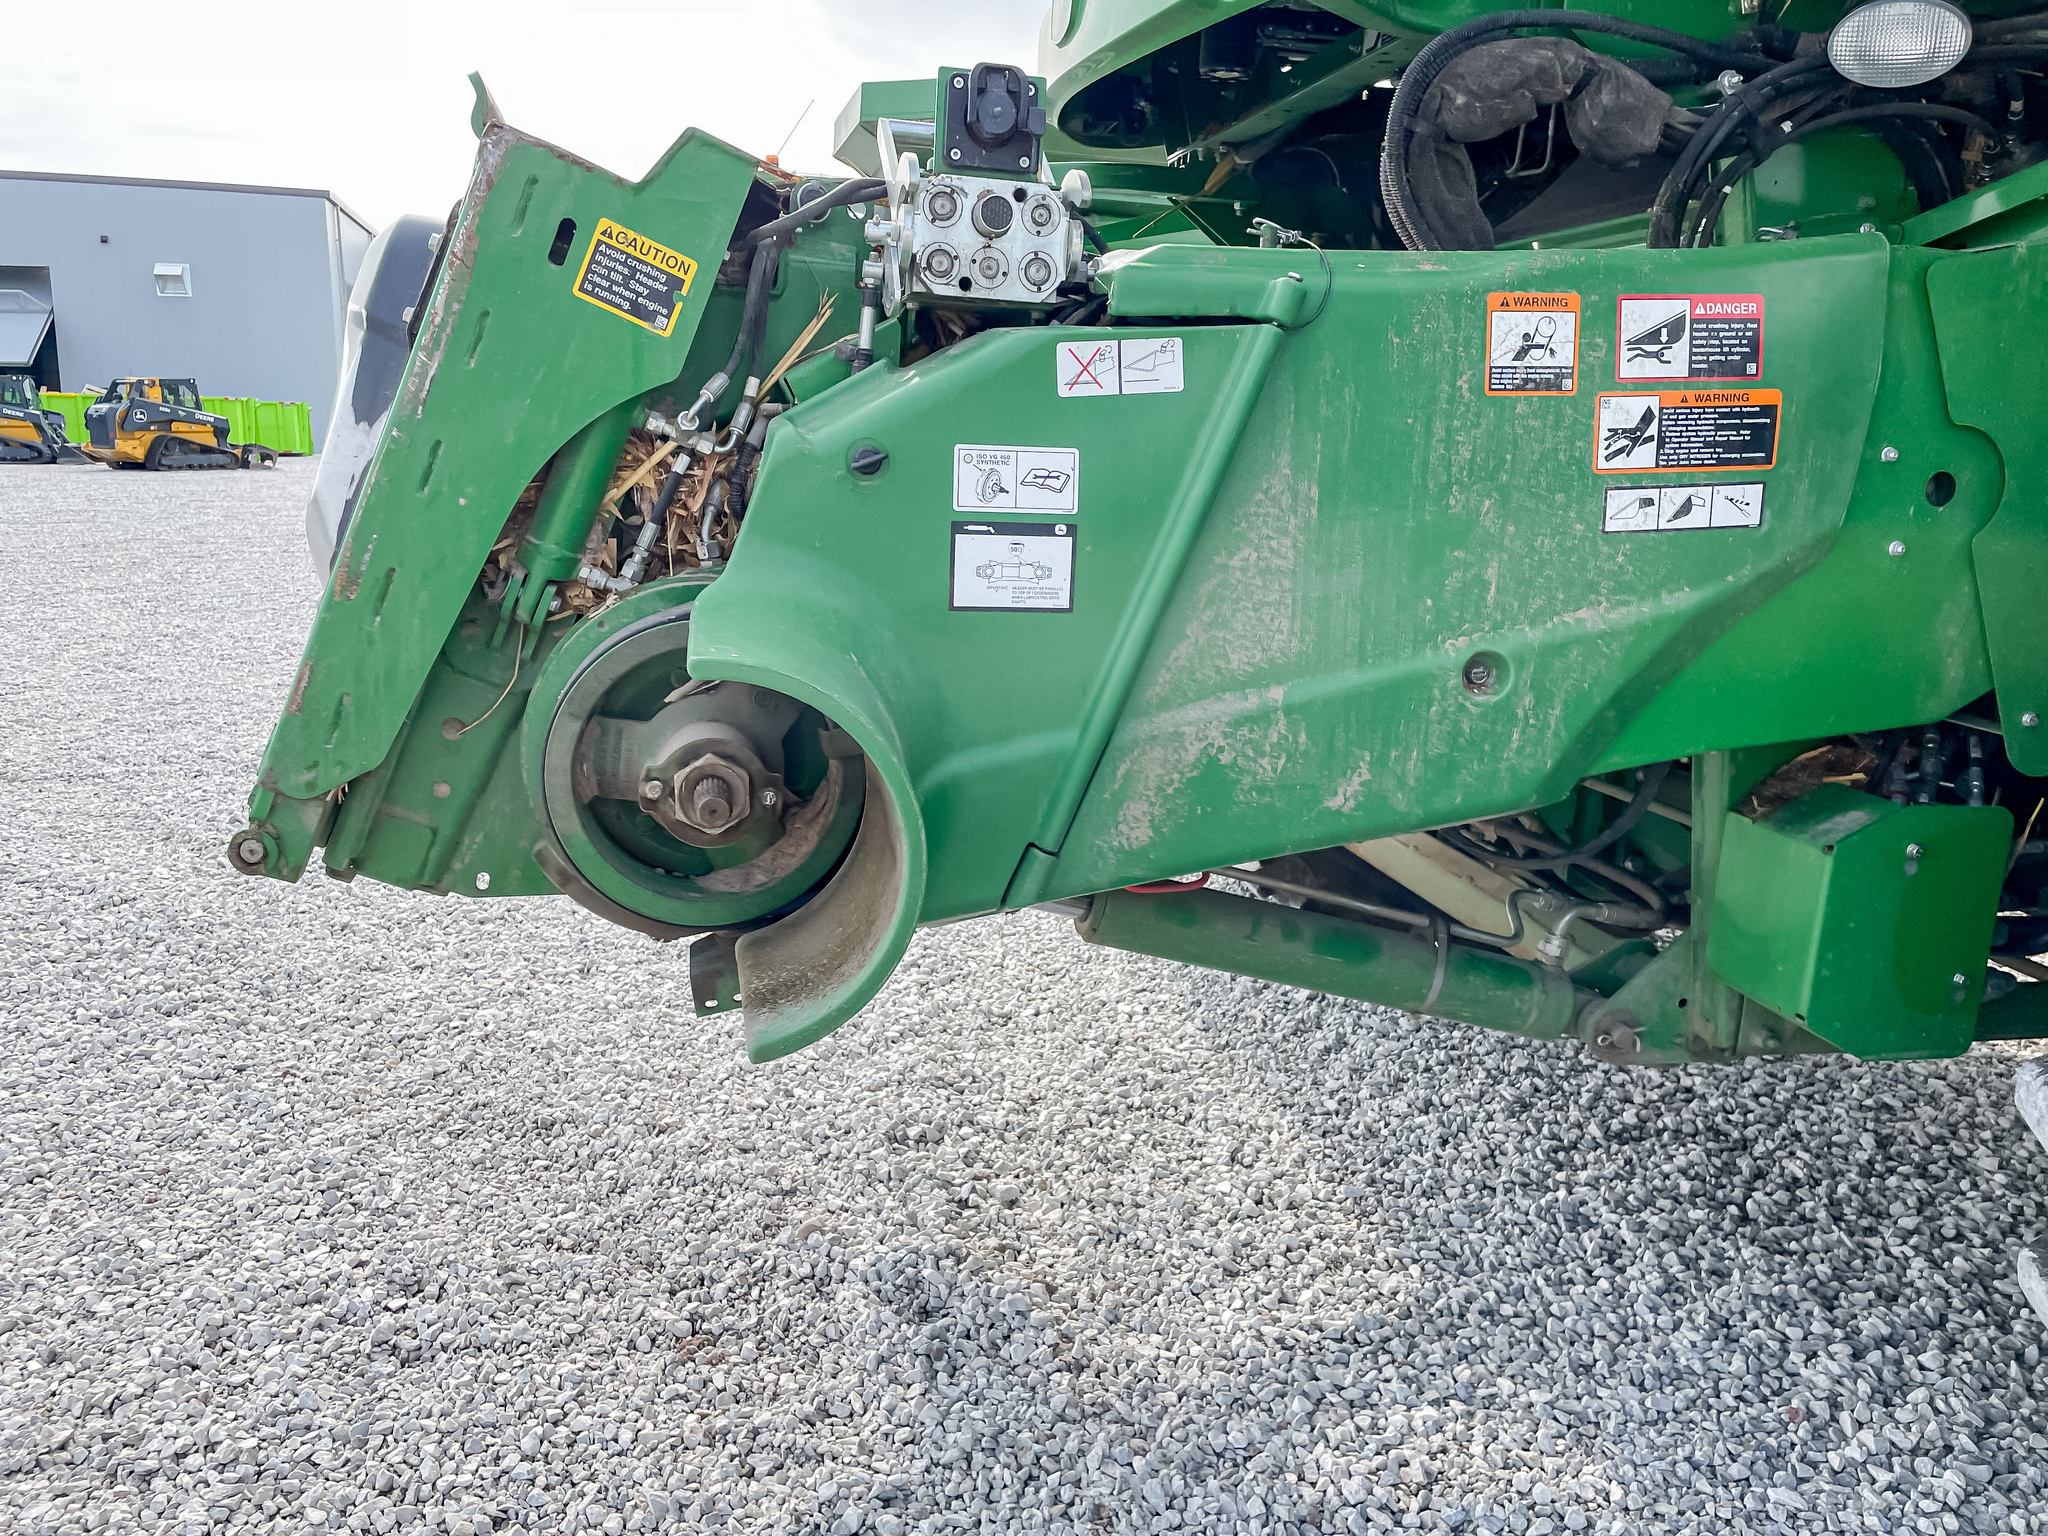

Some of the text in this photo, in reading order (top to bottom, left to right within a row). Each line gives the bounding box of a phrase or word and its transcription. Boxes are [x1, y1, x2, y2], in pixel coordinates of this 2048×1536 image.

[598, 243, 667, 283] Avoid crushing
[616, 230, 691, 276] CAUTION
[595, 253, 668, 293] injuries. Header
[610, 270, 624, 284] tilt.
[628, 280, 650, 296] Stay
[584, 280, 632, 310] is running.
[587, 272, 668, 316] clear when engine
[1513, 297, 1568, 308] WARNING
[1706, 302, 1757, 314] DANGER
[1694, 393, 1750, 403] WARNING
[2, 408, 24, 418] DEERE
[194, 412, 215, 422] DEERE
